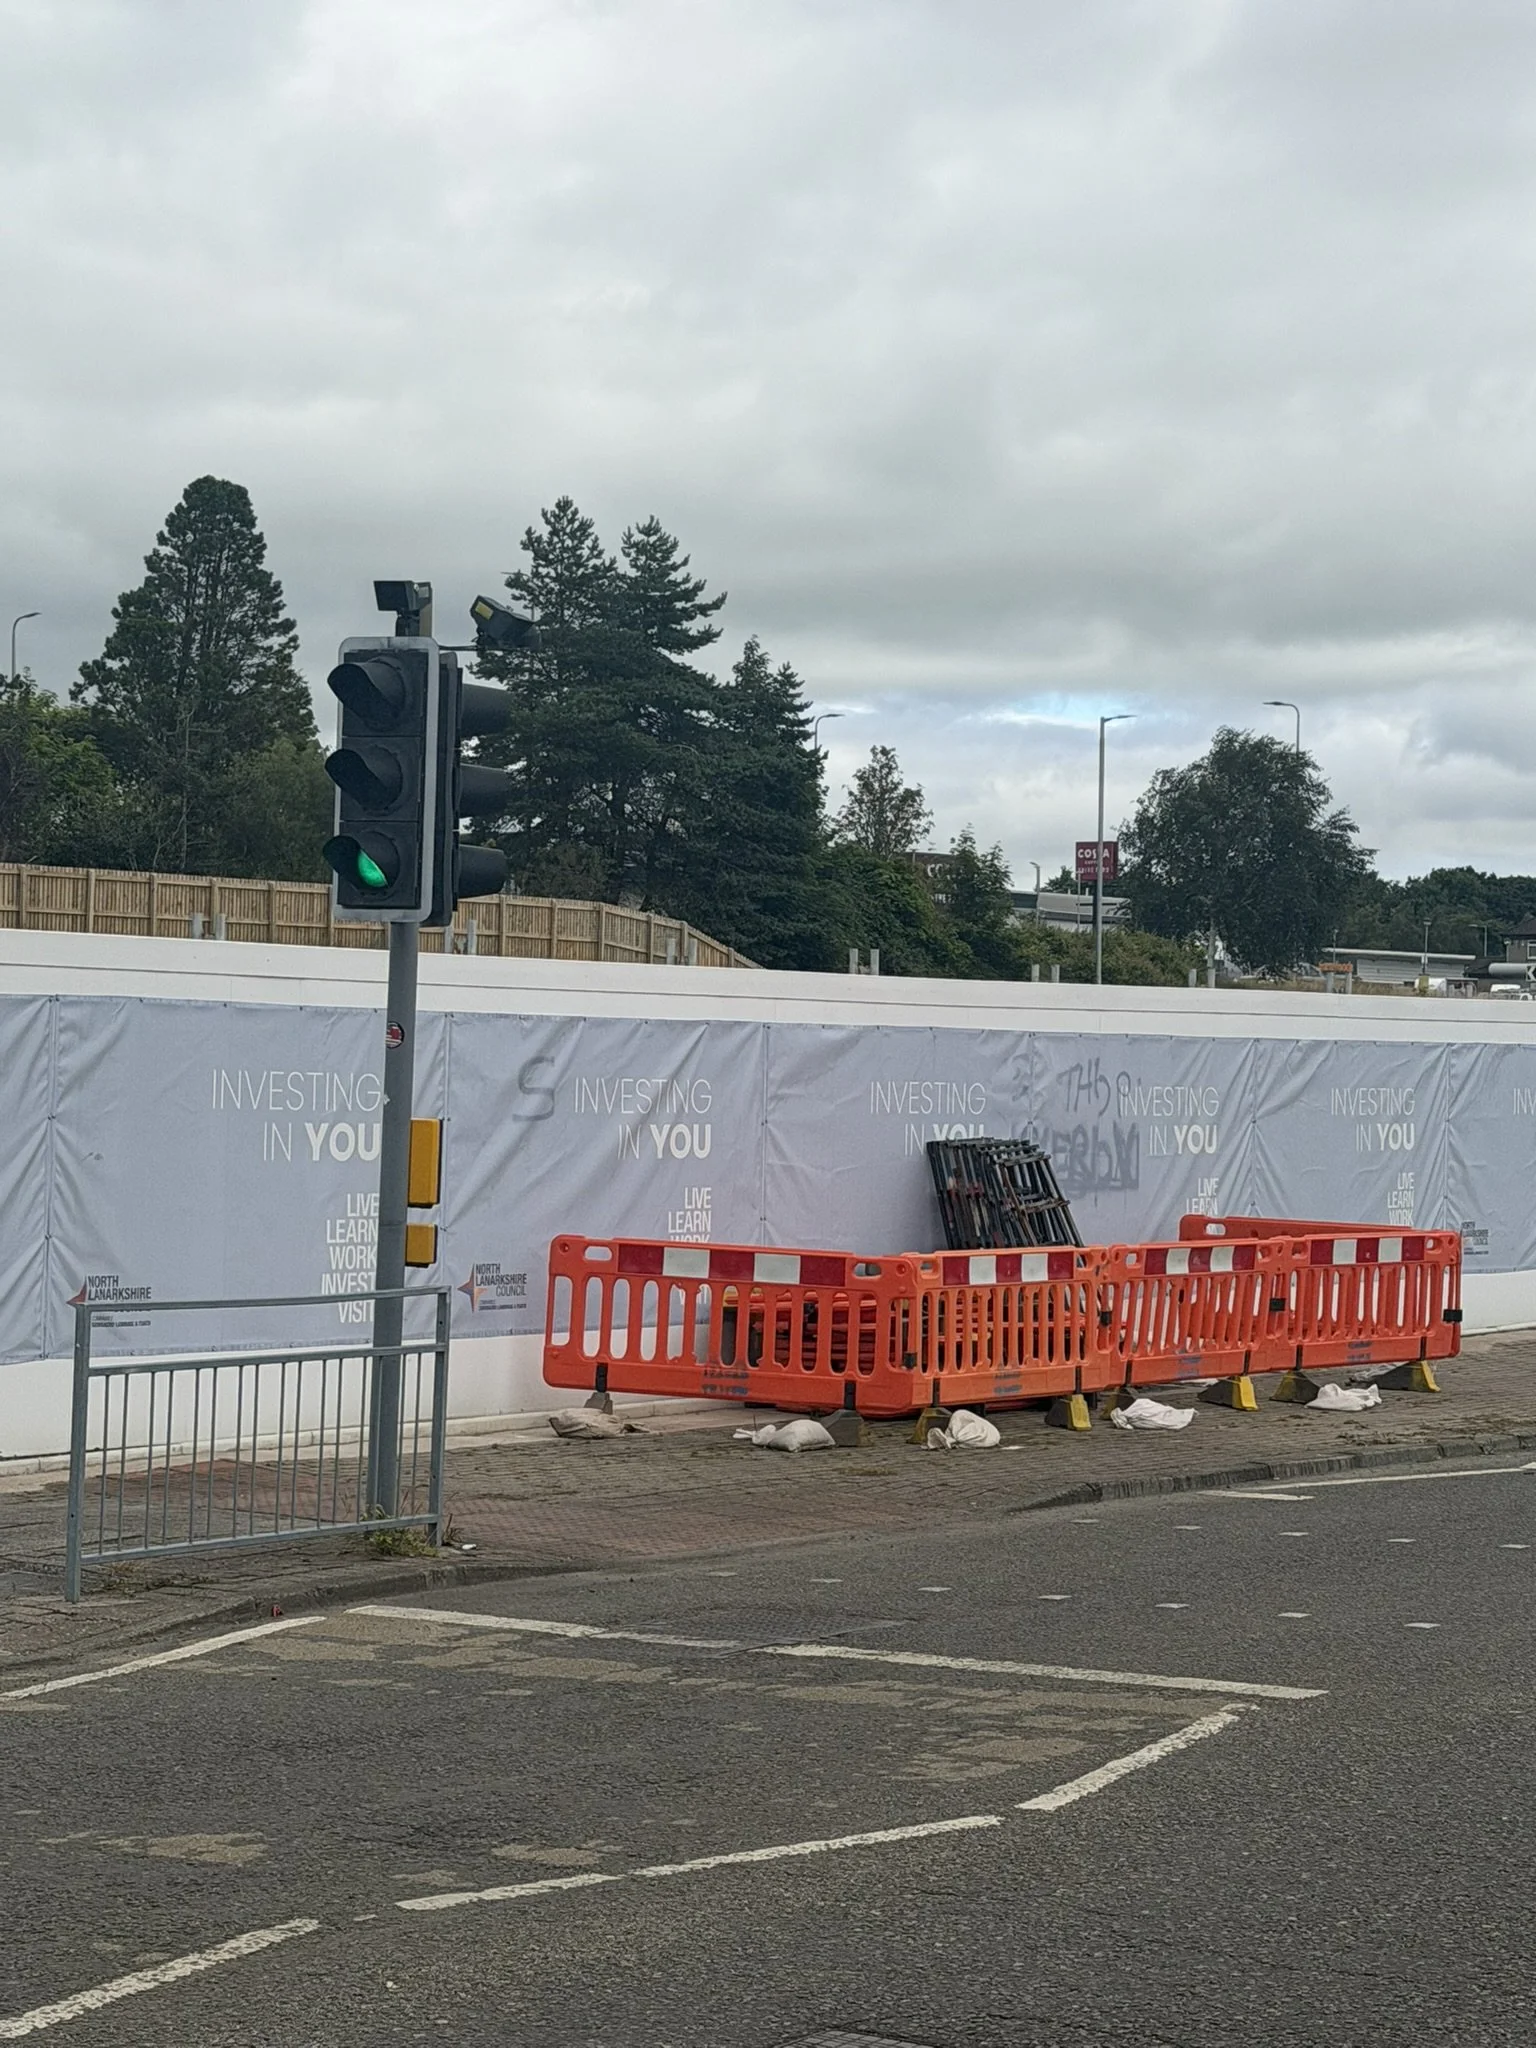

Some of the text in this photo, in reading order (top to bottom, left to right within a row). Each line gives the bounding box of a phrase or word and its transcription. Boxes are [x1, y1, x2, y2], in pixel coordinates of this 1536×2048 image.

[1077, 848, 1110, 859] COSA
[212, 1068, 382, 1112] INVESTING
[574, 1077, 713, 1114] INVESTING
[870, 1081, 987, 1115] INVESTING
[1119, 1086, 1220, 1117] INVESTING
[1330, 1087, 1416, 1117] INVESTING
[263, 1121, 381, 1162] IN YOU
[617, 1123, 712, 1160] IN YOU
[904, 1123, 925, 1156] IN
[1148, 1124, 1217, 1156] IN YOU
[1355, 1122, 1415, 1151] IN YOU
[1198, 1177, 1219, 1197] LIVE
[1397, 1172, 1415, 1190] LIVE
[346, 1192, 380, 1217] LIVE
[684, 1186, 712, 1210] LIVE
[1387, 1190, 1415, 1209] LEARN
[326, 1218, 379, 1244] LEARN
[667, 1210, 712, 1234] LEARN
[328, 1244, 378, 1271] WORK
[475, 1263, 501, 1275] NORTH
[87, 1275, 119, 1288] NORTH
[320, 1271, 377, 1296] INVEST
[475, 1273, 528, 1287] LANARKSHIRE
[495, 1285, 528, 1297] COUNCIL
[87, 1286, 152, 1301] LANARKSHIRE
[338, 1299, 376, 1324] VISIT
